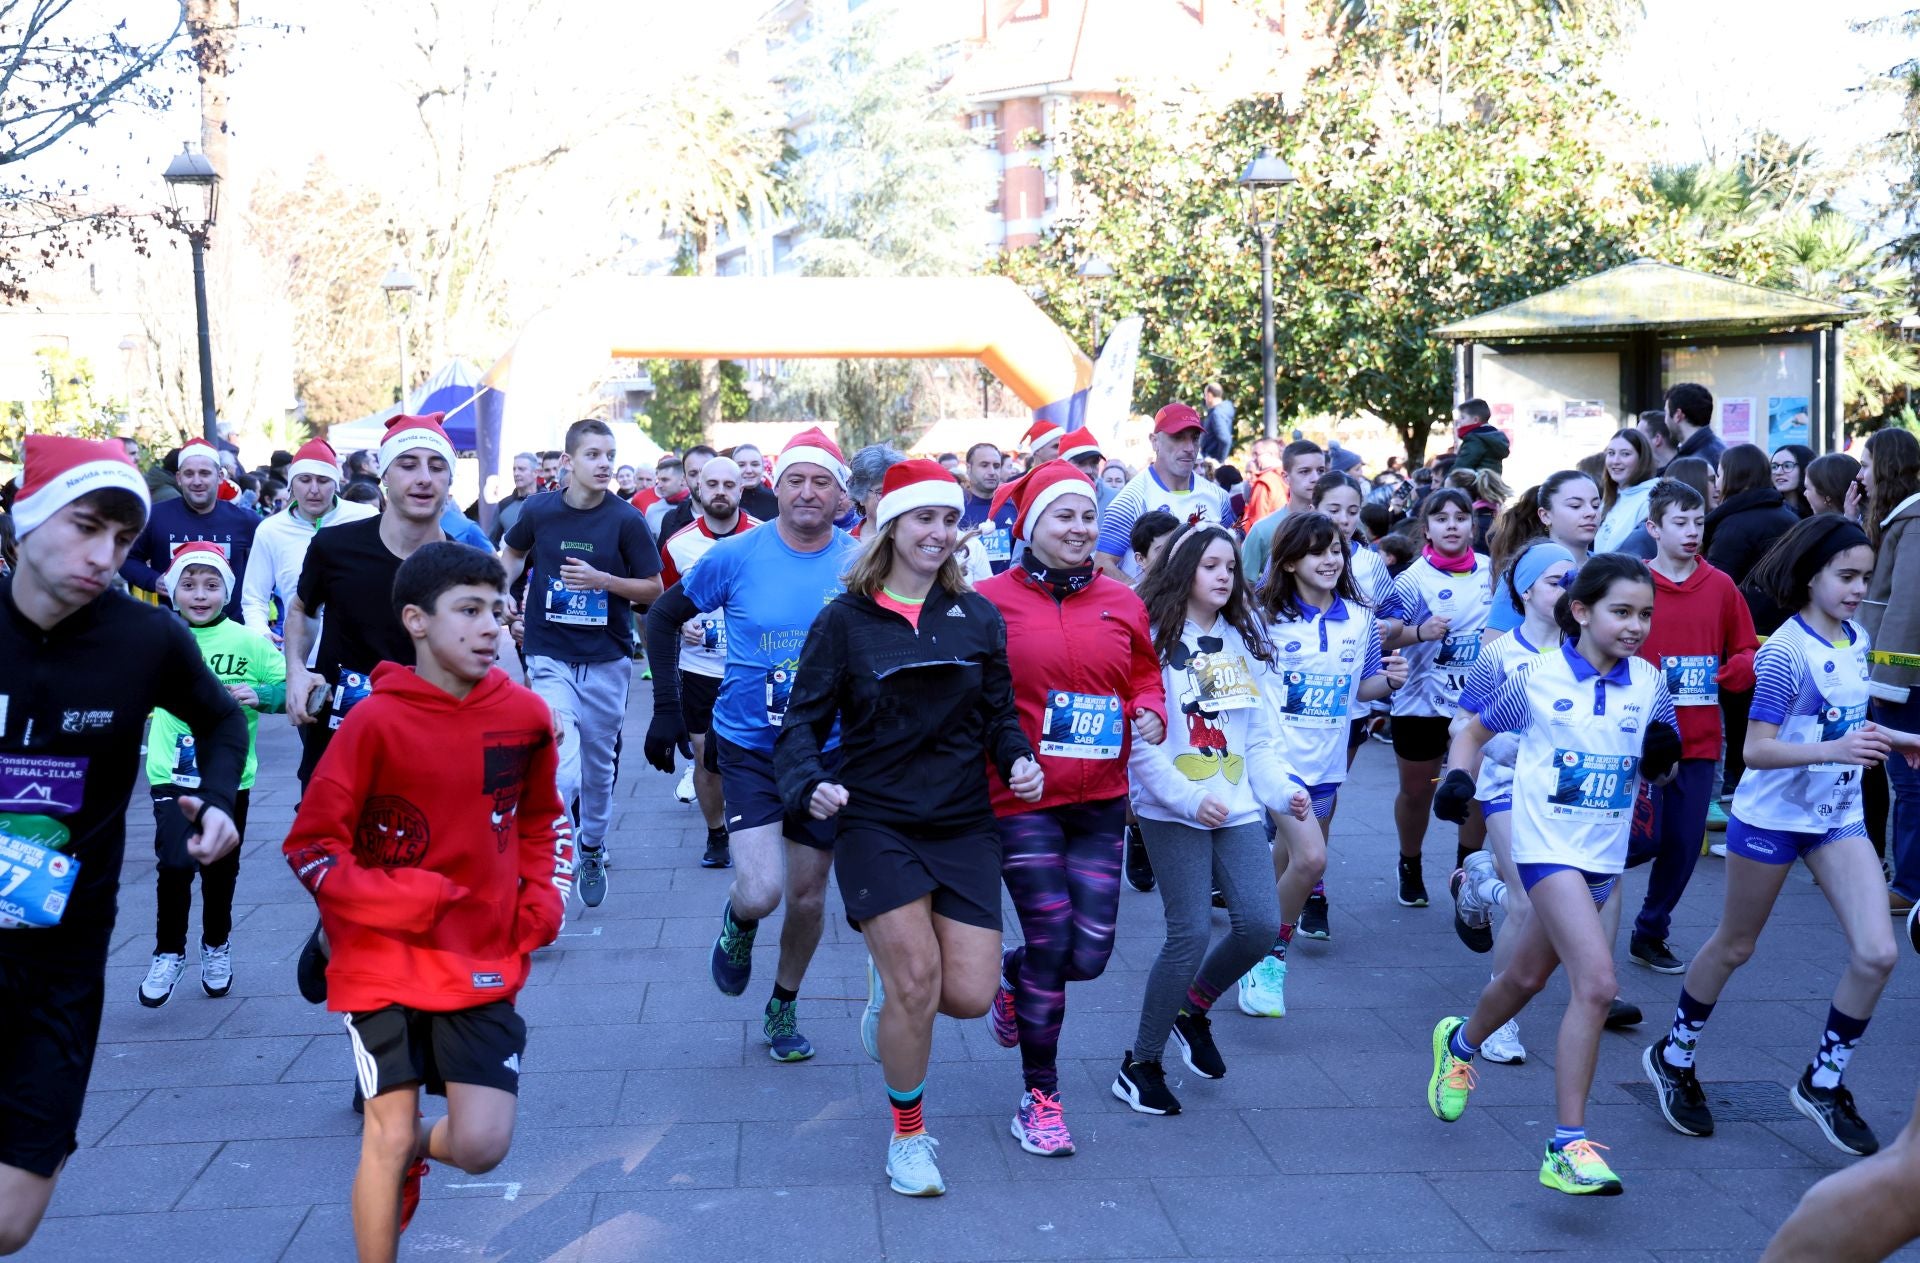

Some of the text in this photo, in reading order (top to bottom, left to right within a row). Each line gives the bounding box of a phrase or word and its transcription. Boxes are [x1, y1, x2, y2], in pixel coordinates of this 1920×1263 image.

[169, 533, 232, 542] PARIS
[568, 594, 587, 609] 43
[1452, 645, 1475, 660] 441
[1680, 669, 1706, 687] 452
[1301, 687, 1335, 708] 424
[1301, 707, 1330, 716] AITANA
[1070, 711, 1105, 735] 169
[1074, 735, 1095, 744] SABI
[5, 767, 83, 779] PERAL-ILLAS
[1580, 772, 1618, 798] 419
[1581, 799, 1610, 808] ALMA
